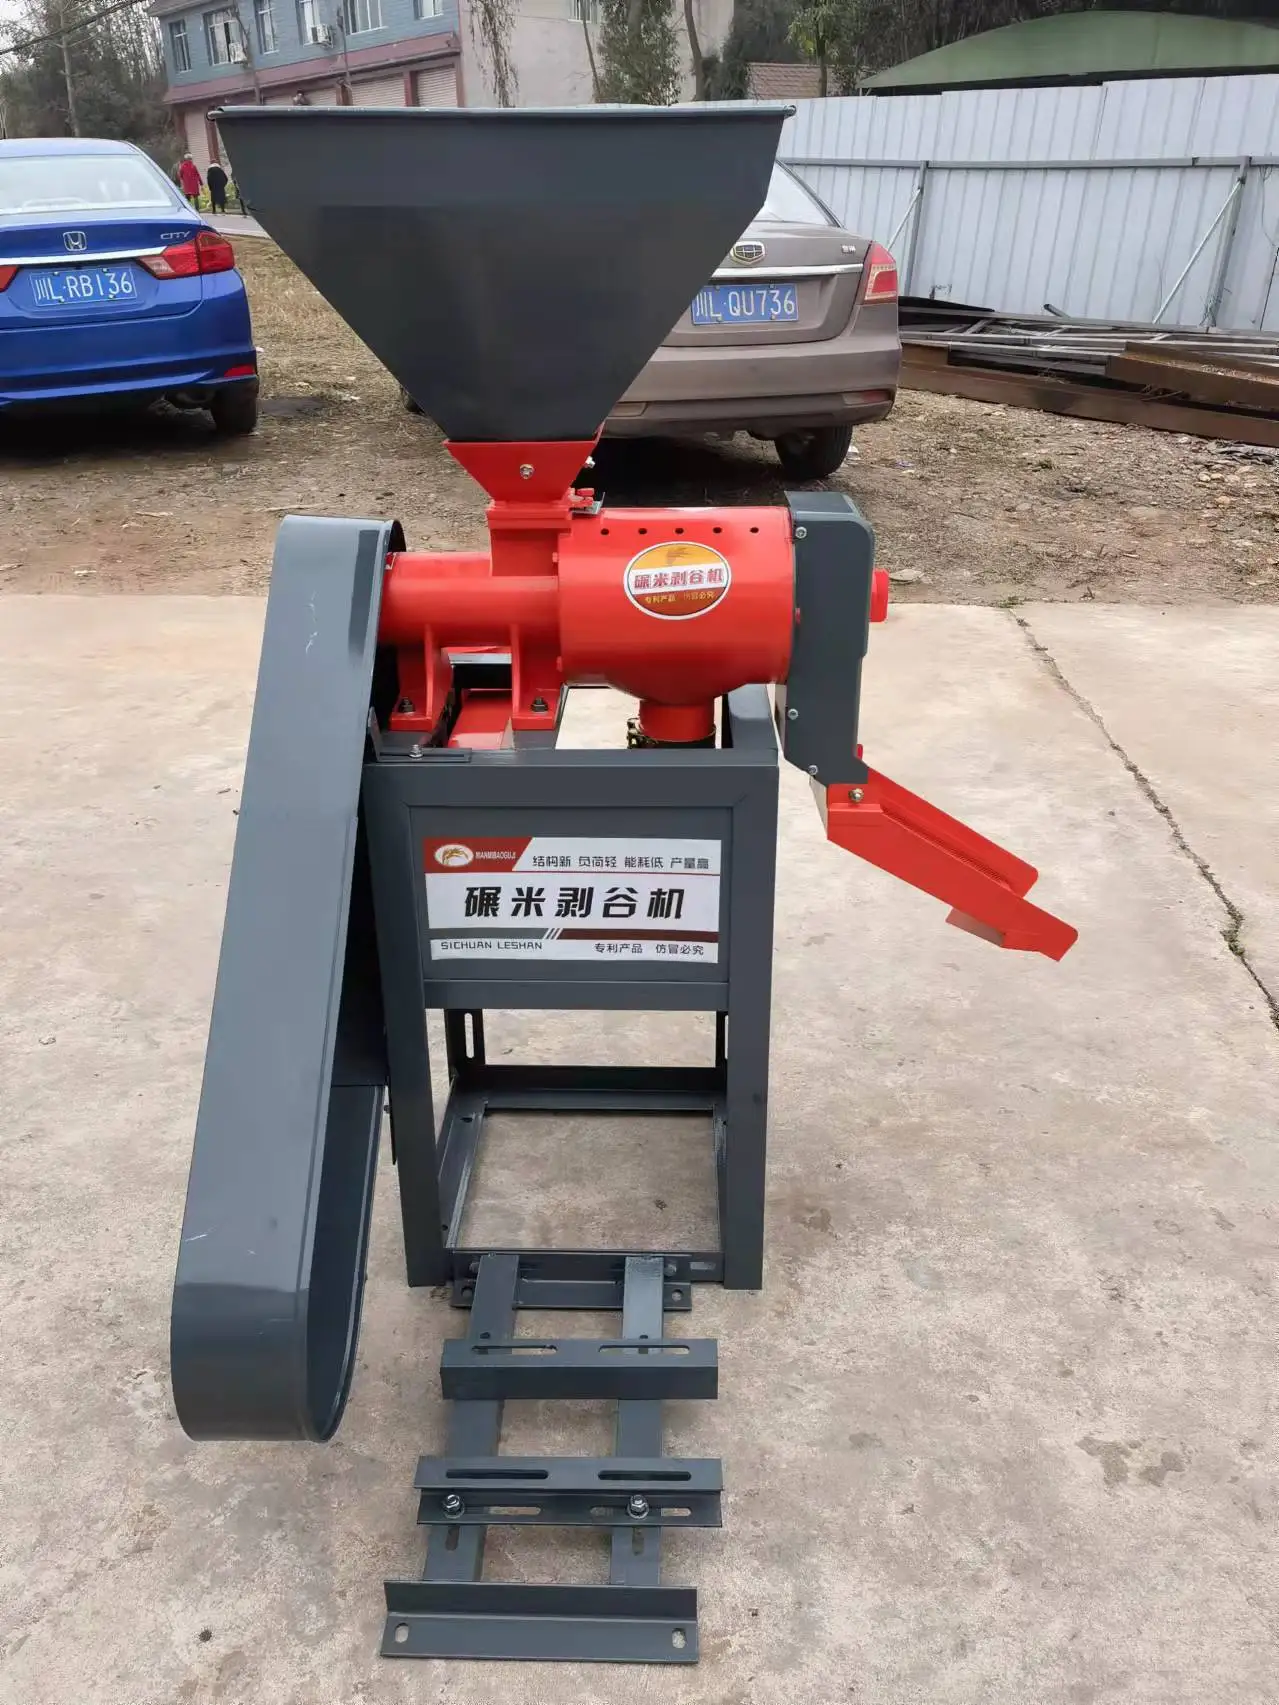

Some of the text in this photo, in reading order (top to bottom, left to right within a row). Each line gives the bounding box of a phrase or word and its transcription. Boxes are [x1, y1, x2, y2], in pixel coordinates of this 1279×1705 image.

[159, 230, 191, 240] CITY
[634, 568, 724, 589] 碾米剥谷机
[532, 855, 709, 870] 结构新 负荷轻 能耗低 产量高
[464, 886, 685, 919] 碾米剥谷机
[441, 941, 543, 950] SICHUAN LESHAN
[594, 942, 704, 956] 专利产品 仿冒必究
